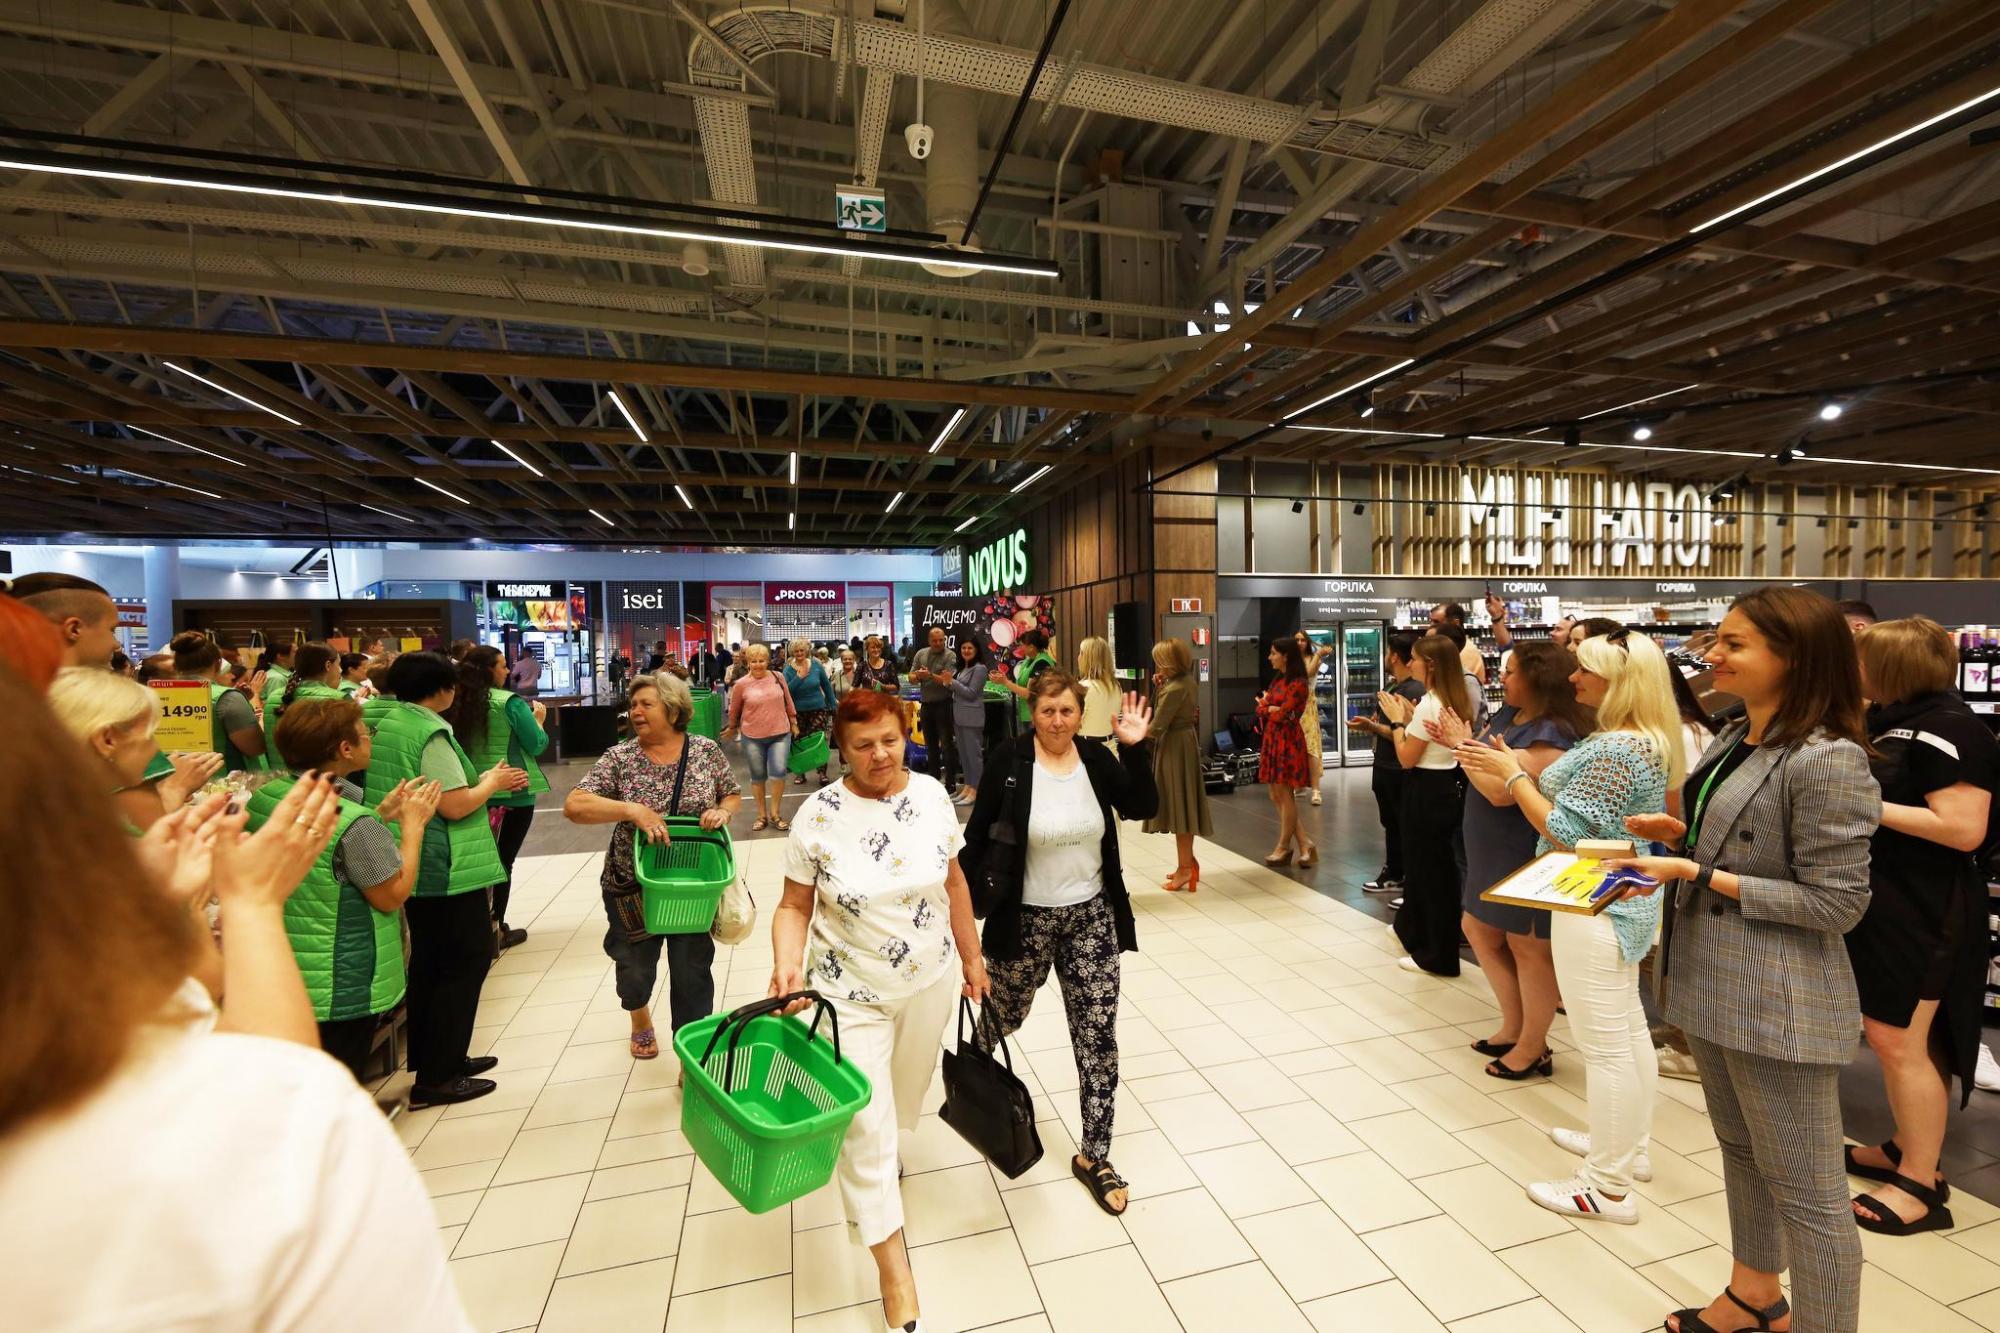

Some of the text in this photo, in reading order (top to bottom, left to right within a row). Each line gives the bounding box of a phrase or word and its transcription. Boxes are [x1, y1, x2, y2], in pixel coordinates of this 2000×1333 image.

[1461, 474, 1570, 568] МІЦНІ
[969, 529, 1027, 597] NOVUS
[1325, 582, 1375, 593] ГОРІЛКА
[1503, 582, 1547, 593] ГОРІЛКА
[1656, 583, 1696, 593] ГОРІЛКА
[623, 588, 663, 609] isei
